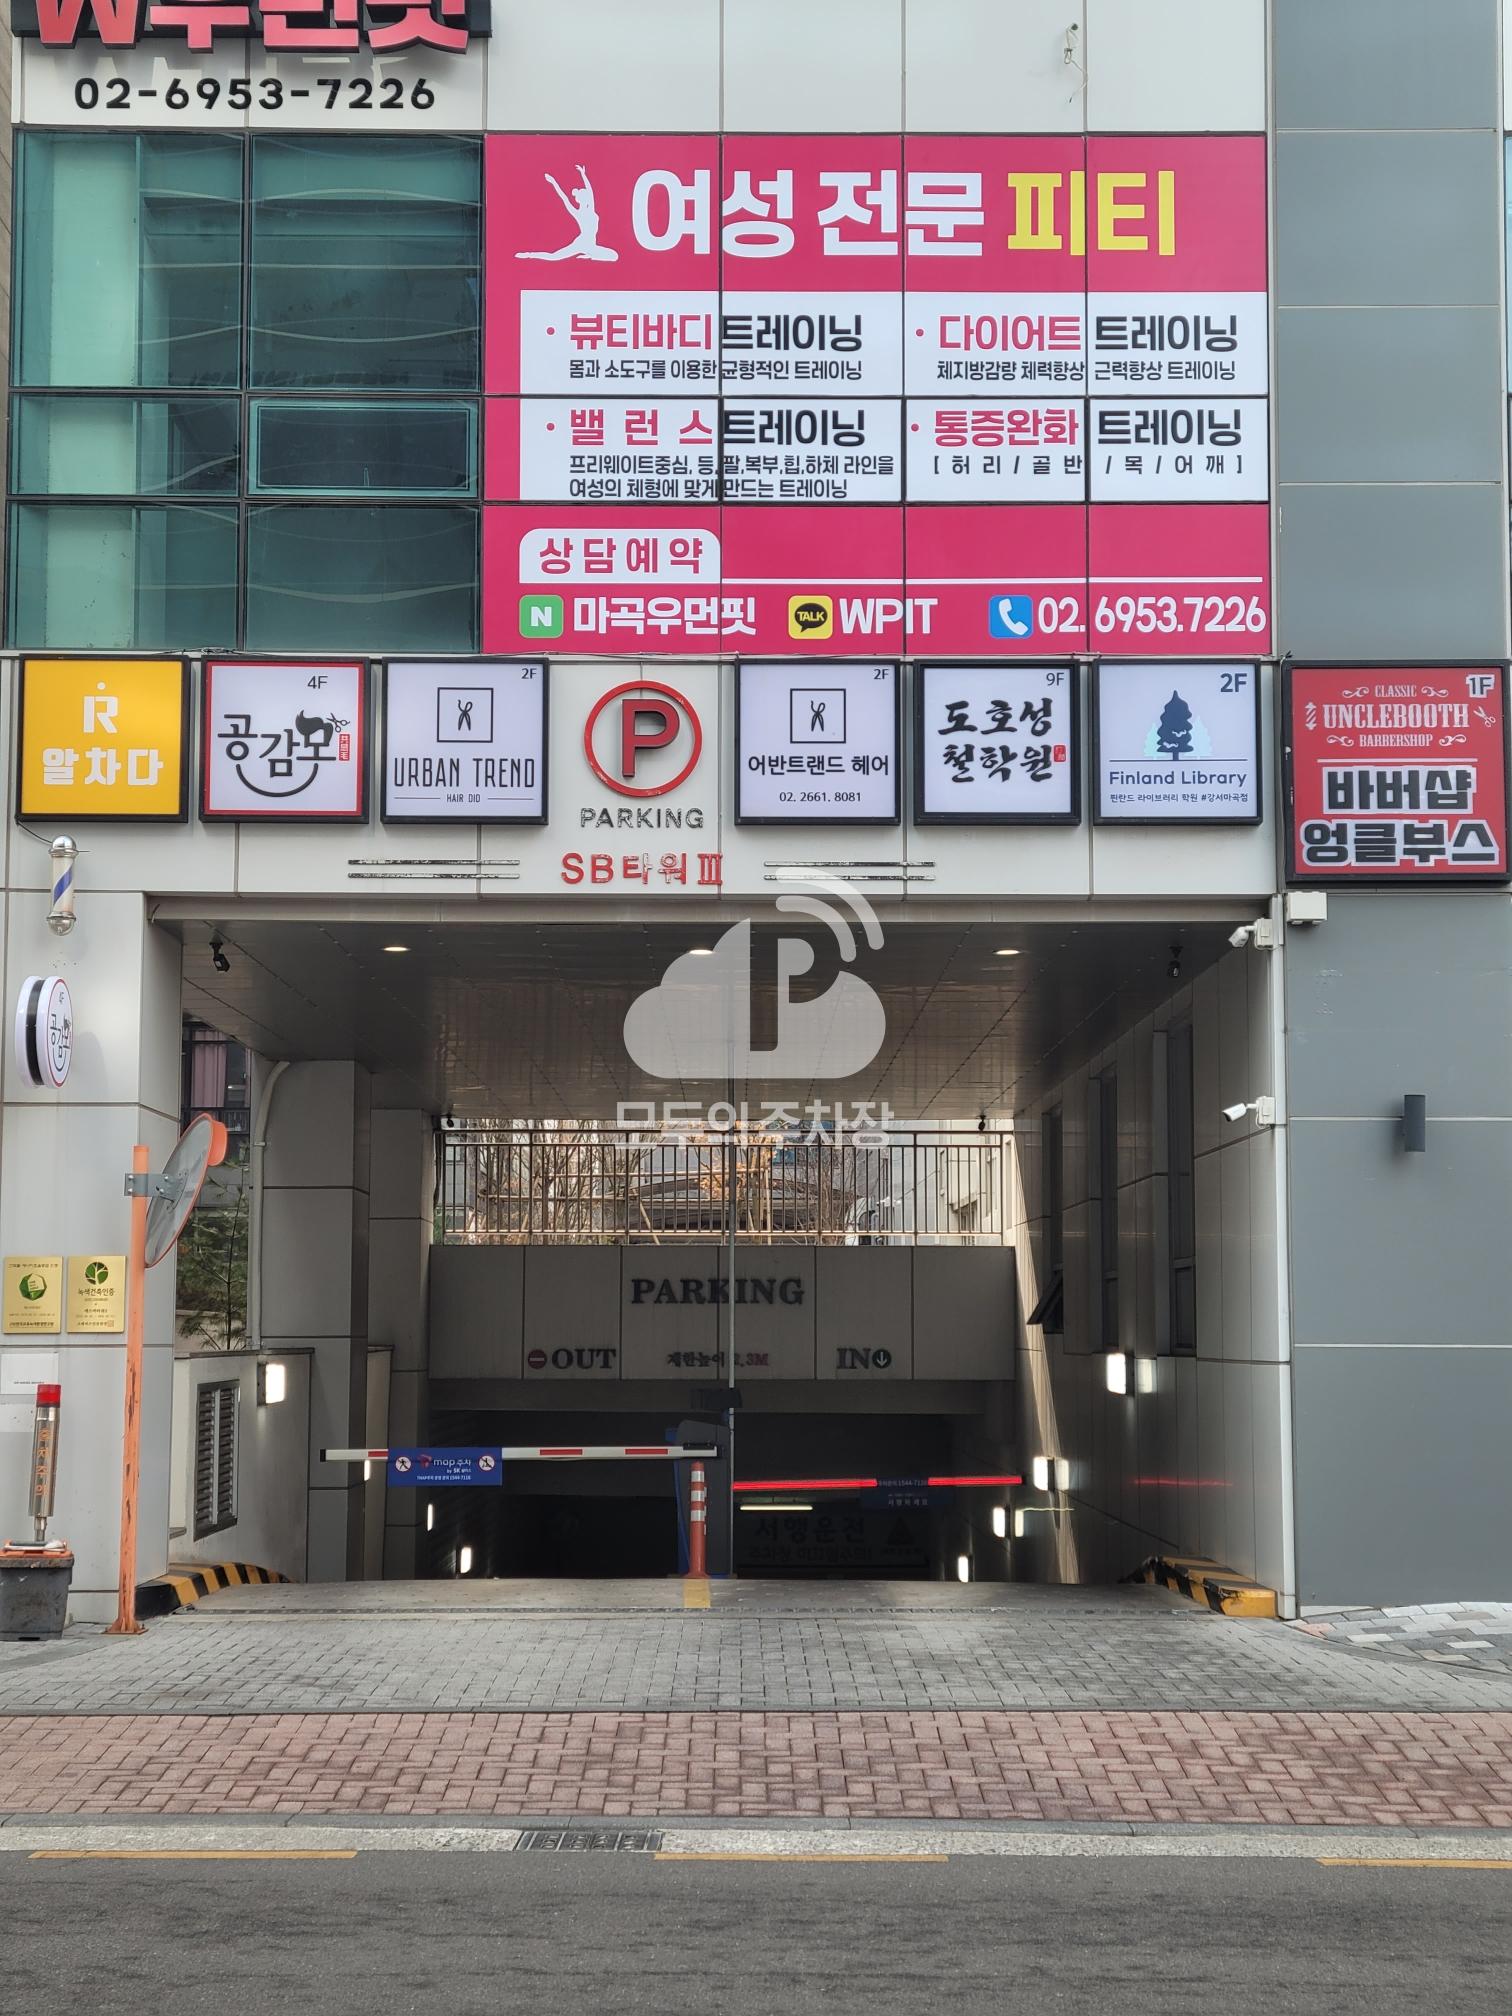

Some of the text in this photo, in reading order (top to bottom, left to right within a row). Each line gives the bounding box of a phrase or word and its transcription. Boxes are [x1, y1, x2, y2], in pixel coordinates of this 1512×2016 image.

[73, 77, 436, 110] 02-6953-7226
[632, 168, 1176, 258] 여성 전문 피티
[569, 313, 863, 354] 뷰티바디 트레이닝
[939, 314, 1238, 353] 다이어트 트레이닝
[569, 359, 863, 381] 몸과 소도구를 이용한 균형적인 트레이닝
[936, 360, 1237, 381] 체지방감량 체력향상 근력향상 트레이닝
[723, 408, 866, 448] 트레이닝
[934, 408, 1243, 448] 통증완화 트레이닝
[843, 454, 895, 477] 라인을
[569, 478, 848, 500] 여성의 체형에 맞게 만드는 트레이닝
[573, 595, 757, 636] 마곡우먼핏
[796, 611, 825, 623] TALK
[840, 597, 939, 635] WPIT
[307, 675, 329, 690] 4F
[521, 668, 538, 680] 2F
[872, 668, 890, 680] 2F
[1045, 672, 1066, 687] 9F
[1220, 673, 1248, 694] 2F
[1374, 685, 1418, 698] CLASSIC
[1468, 675, 1494, 697] 1F
[937, 697, 1054, 738] 도호성
[1322, 703, 1470, 730] UNCLEBOOTH
[217, 709, 337, 778] 공감모
[621, 698, 681, 778] P
[1359, 734, 1434, 748] BARBERSHOP
[394, 757, 536, 788] URBAN TREND
[748, 755, 889, 776] 어반트랜드 헤어
[942, 743, 1054, 784] 철학원
[1109, 771, 1248, 788] Finland Library
[1325, 768, 1474, 811] 바버샵
[446, 793, 464, 803] HAIR
[1110, 793, 1136, 803] 핀란드
[1137, 793, 1179, 804] 라이브러리
[1181, 793, 1199, 804] 학원
[579, 807, 705, 829] PARKING
[1302, 821, 1497, 864] 엉클부스
[630, 1277, 806, 1306] PARKING
[551, 1347, 617, 1371] OUT
